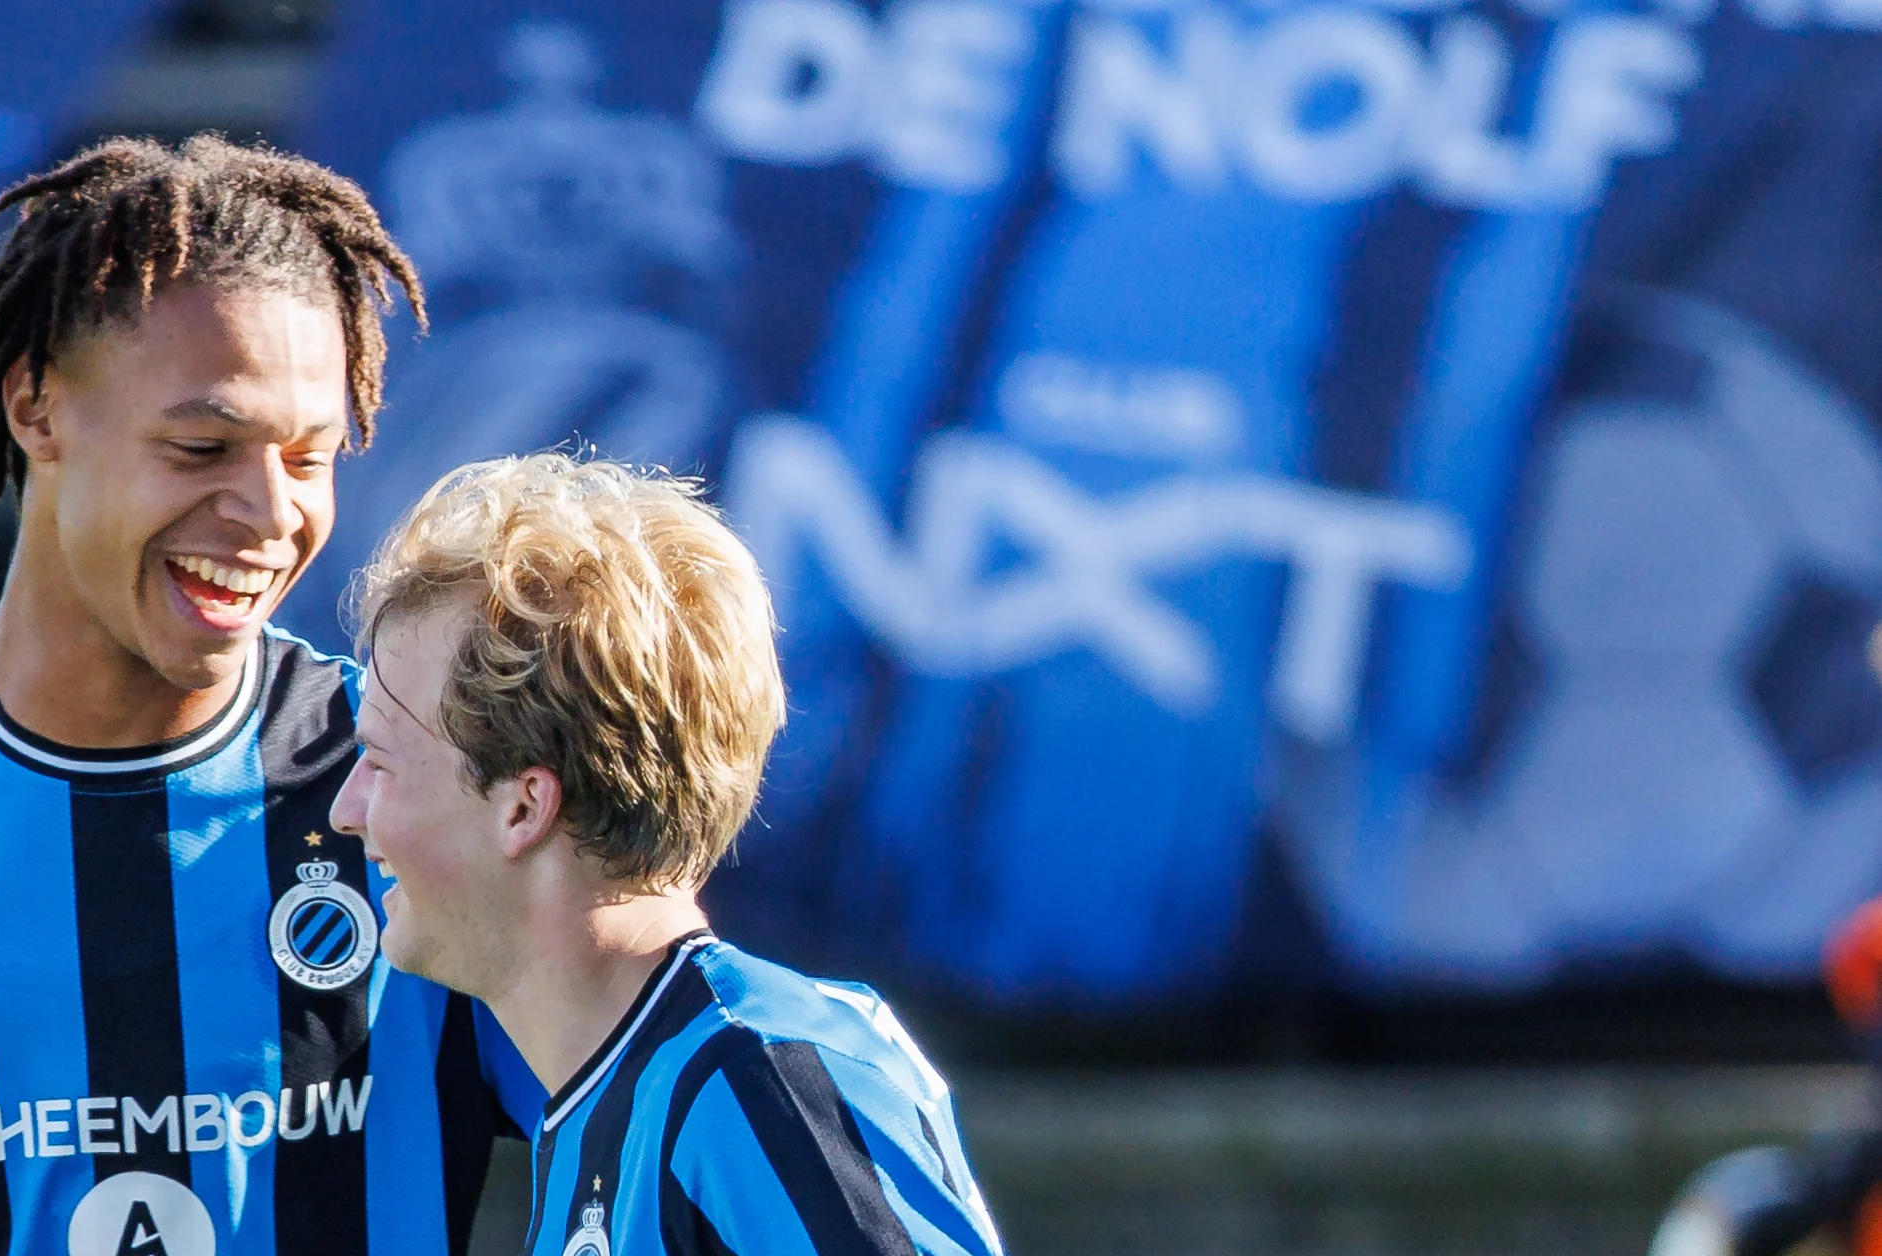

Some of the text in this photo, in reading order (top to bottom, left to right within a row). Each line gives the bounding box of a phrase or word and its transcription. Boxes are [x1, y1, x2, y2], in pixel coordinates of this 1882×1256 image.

[696, 0, 1706, 208] DE NOLF
[730, 412, 1473, 740] NXT
